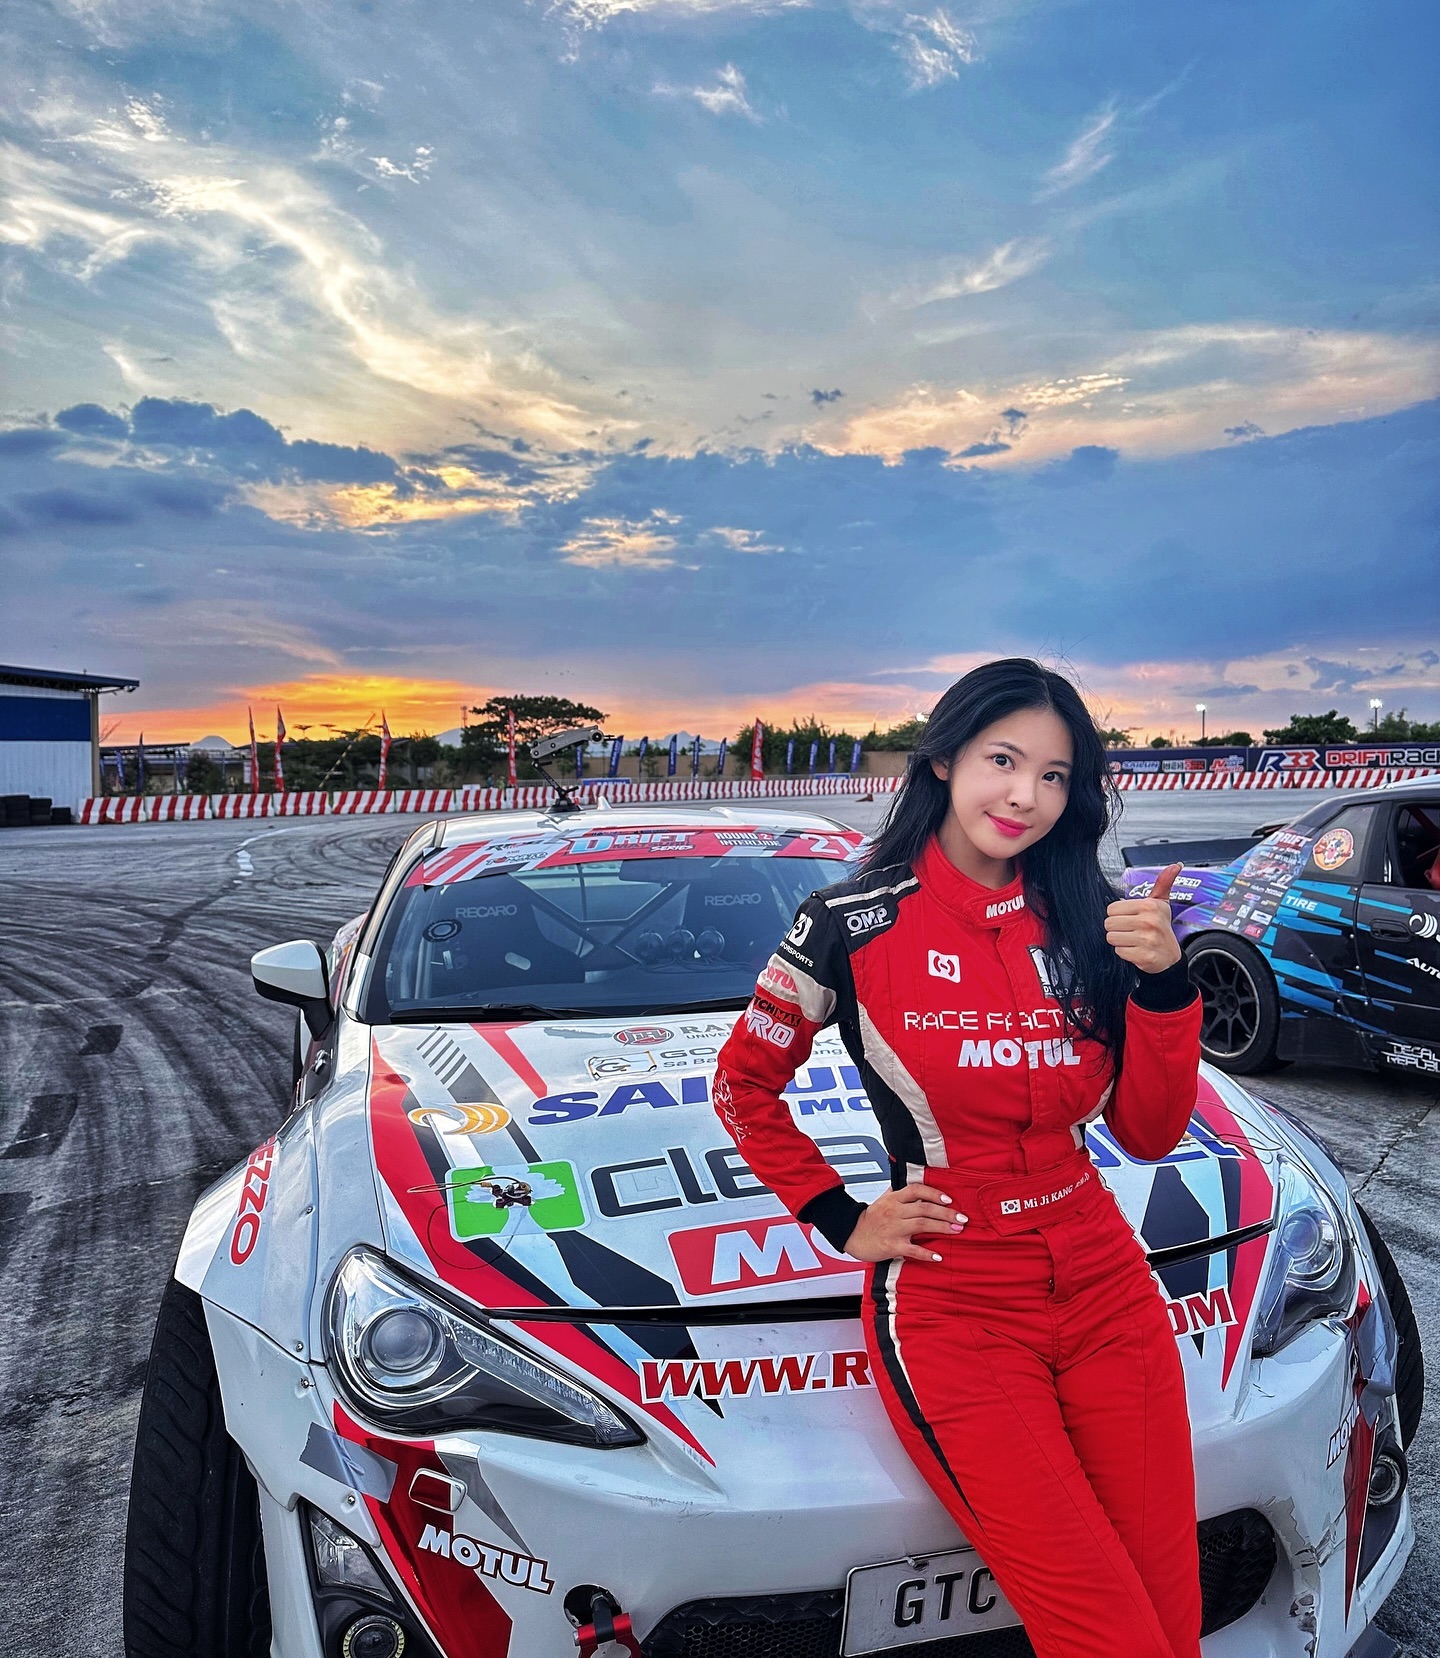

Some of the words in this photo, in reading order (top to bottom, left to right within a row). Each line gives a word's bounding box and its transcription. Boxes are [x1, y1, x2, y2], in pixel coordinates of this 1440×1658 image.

[568, 831, 699, 855] DRIFT
[714, 832, 758, 840] ROUND
[1263, 831, 1313, 848] DRIFT
[648, 844, 696, 853] SERIES
[705, 893, 762, 906] RECARO
[1286, 895, 1317, 911] TIRE
[455, 904, 517, 919] RECARO
[846, 908, 888, 932] OMP
[903, 1010, 979, 1031] RACE
[958, 1037, 1081, 1070] MOTUL
[1023, 1198, 1038, 1210] Mi
[1040, 1194, 1051, 1206] Ji
[1050, 1184, 1074, 1202] KANG
[417, 1523, 553, 1594] MOTUL
